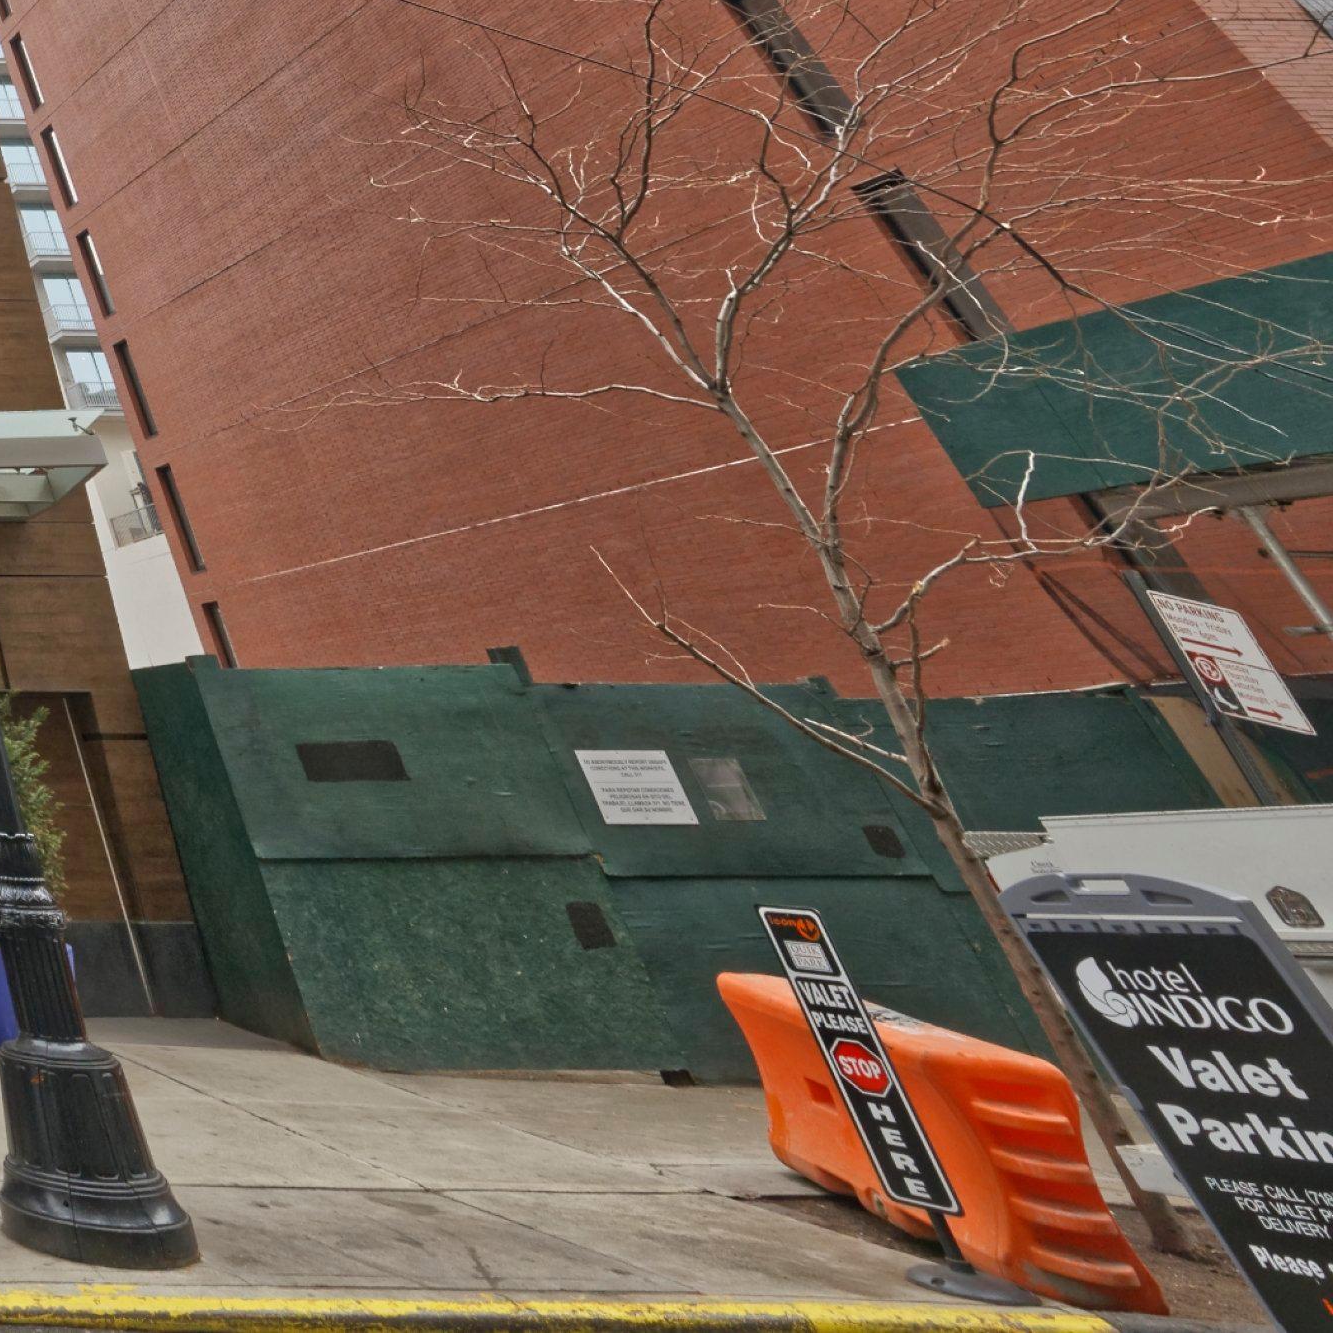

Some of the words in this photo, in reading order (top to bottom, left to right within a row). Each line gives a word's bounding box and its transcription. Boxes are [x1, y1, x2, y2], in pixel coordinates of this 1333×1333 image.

[1157, 598, 1175, 611] NO
[1176, 602, 1225, 624] PARKING
[1105, 960, 1203, 993] hotel
[797, 980, 855, 1011] VALET
[810, 1010, 869, 1035] PLEASE
[1126, 991, 1295, 1035] INDIGO
[838, 1054, 882, 1080] STOP
[1146, 1044, 1310, 1100] Valet
[867, 1101, 932, 1201] HERE
[1204, 1176, 1264, 1197] PLEASE
[1263, 1184, 1306, 1203] CALL
[1234, 1195, 1271, 1215] FOR
[1269, 1201, 1317, 1221] VALET
[1257, 1215, 1332, 1240] DELIVERY
[1248, 1244, 1326, 1280] Please
